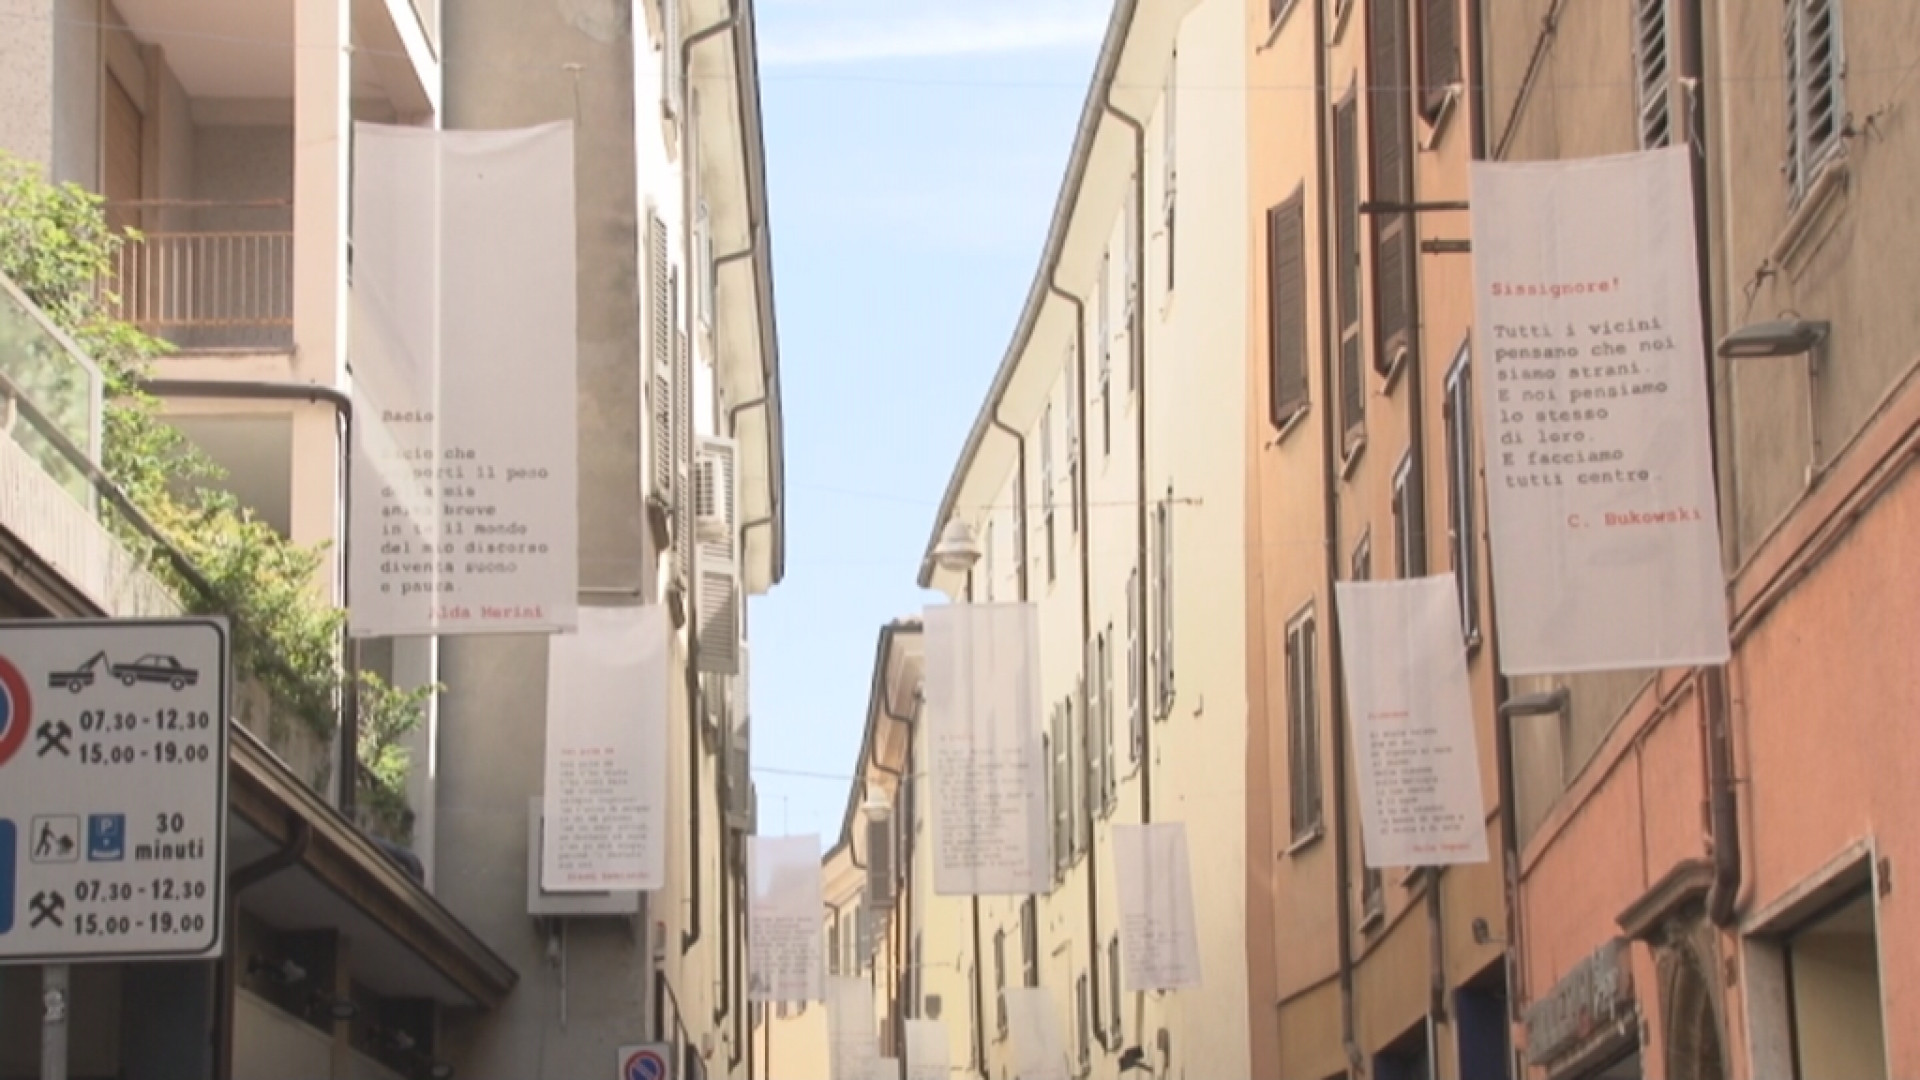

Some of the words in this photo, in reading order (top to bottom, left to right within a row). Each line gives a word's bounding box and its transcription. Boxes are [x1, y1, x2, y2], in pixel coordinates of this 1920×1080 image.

[1491, 277, 1621, 298] Sissignore!
[1494, 323, 1551, 338] Tutti
[1566, 321, 1576, 337] i
[1588, 316, 1663, 335] vicini
[1495, 346, 1579, 363] pensano
[1591, 341, 1627, 356] che
[1639, 335, 1676, 351] noi
[1497, 367, 1556, 381] siamo
[1568, 362, 1652, 378] strani.
[1497, 388, 1511, 402] E
[1522, 386, 1556, 400] noi
[1569, 380, 1668, 403] pensiamo
[1500, 409, 1524, 424] lo
[1535, 406, 1609, 422] stesso
[1500, 430, 1524, 445] di
[382, 448, 434, 461] cio
[444, 447, 476, 460] che
[1502, 451, 1516, 466] E
[1527, 449, 1624, 465] facciamo
[477, 466, 496, 479] il
[505, 467, 549, 482] peso
[1505, 473, 1564, 488] tutti
[443, 485, 476, 498] mia
[443, 504, 497, 517] breve
[1567, 513, 1591, 528] C.
[1604, 506, 1702, 527] Bukowski
[381, 523, 402, 536] in
[444, 522, 464, 535] il
[474, 521, 528, 535] mondo
[380, 541, 411, 555] del
[464, 540, 549, 554] discorso
[464, 561, 518, 574] suono
[428, 604, 472, 620] lda
[480, 604, 544, 619] Merini
[79, 710, 137, 731] 07.30
[155, 709, 209, 731] 12.30
[79, 743, 135, 765] 15.00
[154, 742, 209, 763] 19.00
[156, 813, 184, 834] 30
[135, 838, 204, 861] minuti
[75, 881, 132, 902] 07.30
[151, 878, 206, 900] 12.30
[74, 914, 131, 936] 15.00
[149, 913, 204, 934] 19.00
